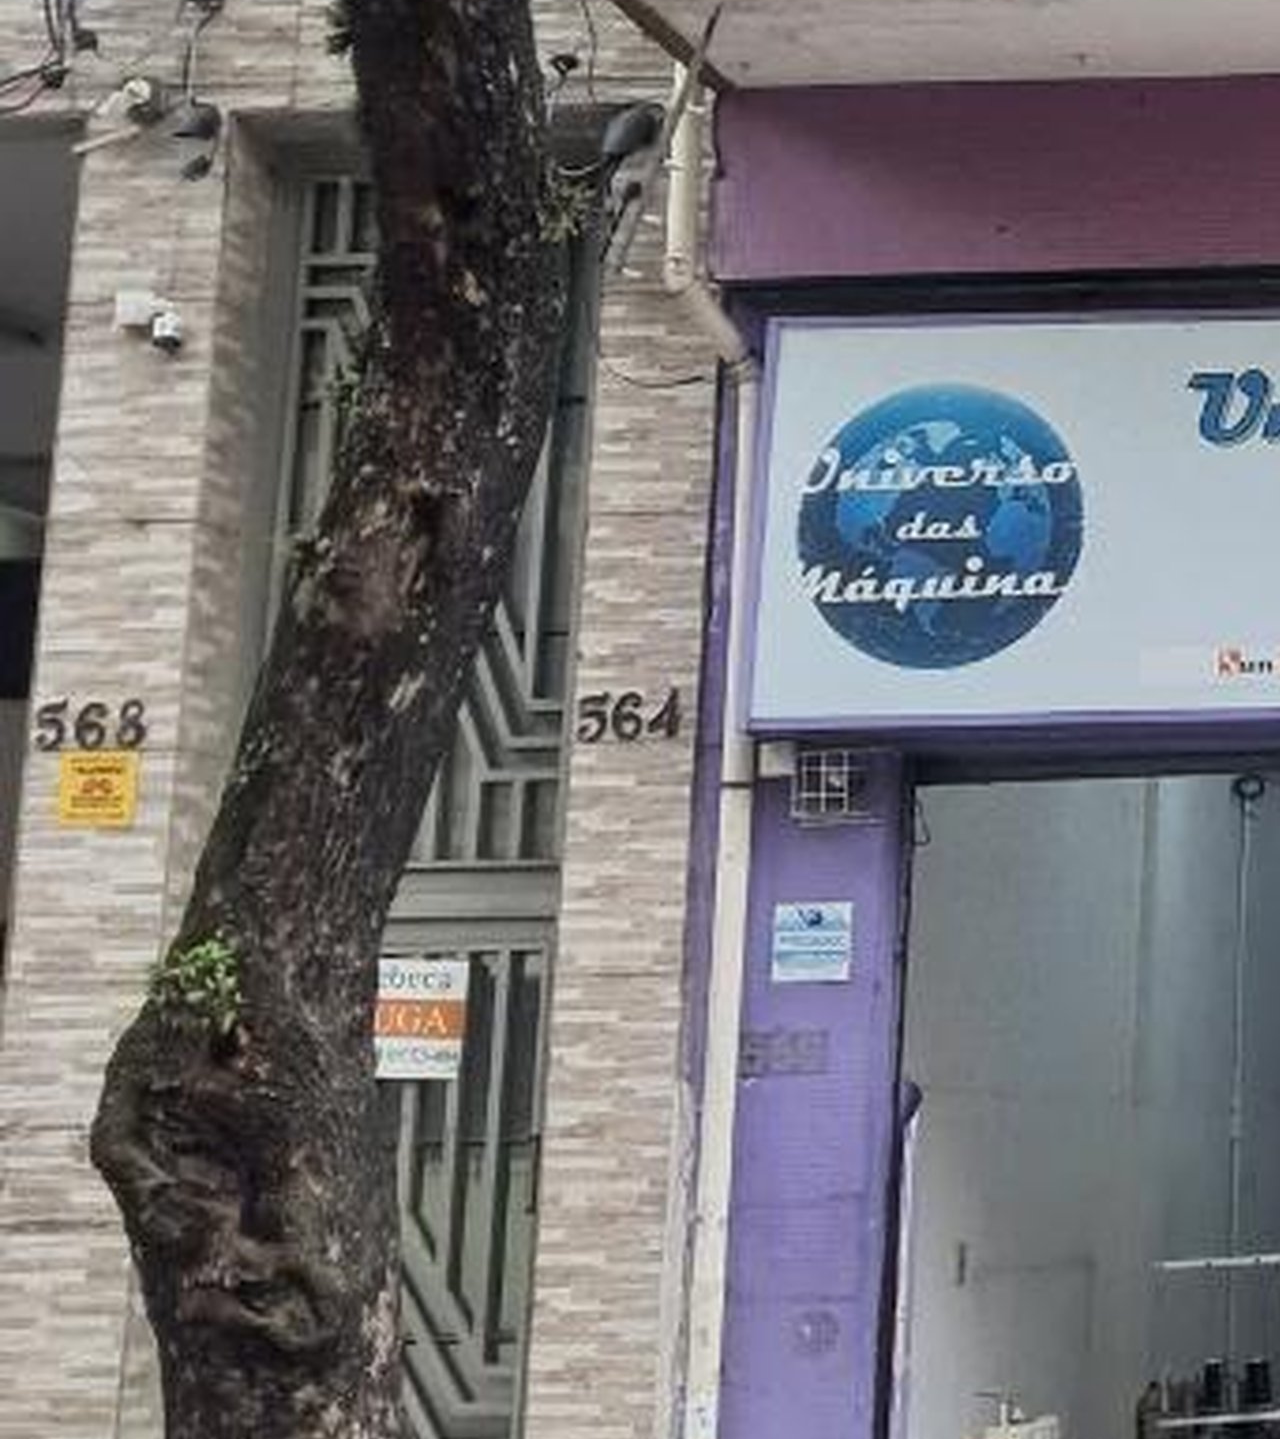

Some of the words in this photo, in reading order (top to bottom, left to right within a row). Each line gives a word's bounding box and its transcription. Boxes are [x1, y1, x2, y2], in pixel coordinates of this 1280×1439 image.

[896, 512, 982, 540] das
[36, 699, 146, 751] 568
[578, 688, 681, 744] 564
